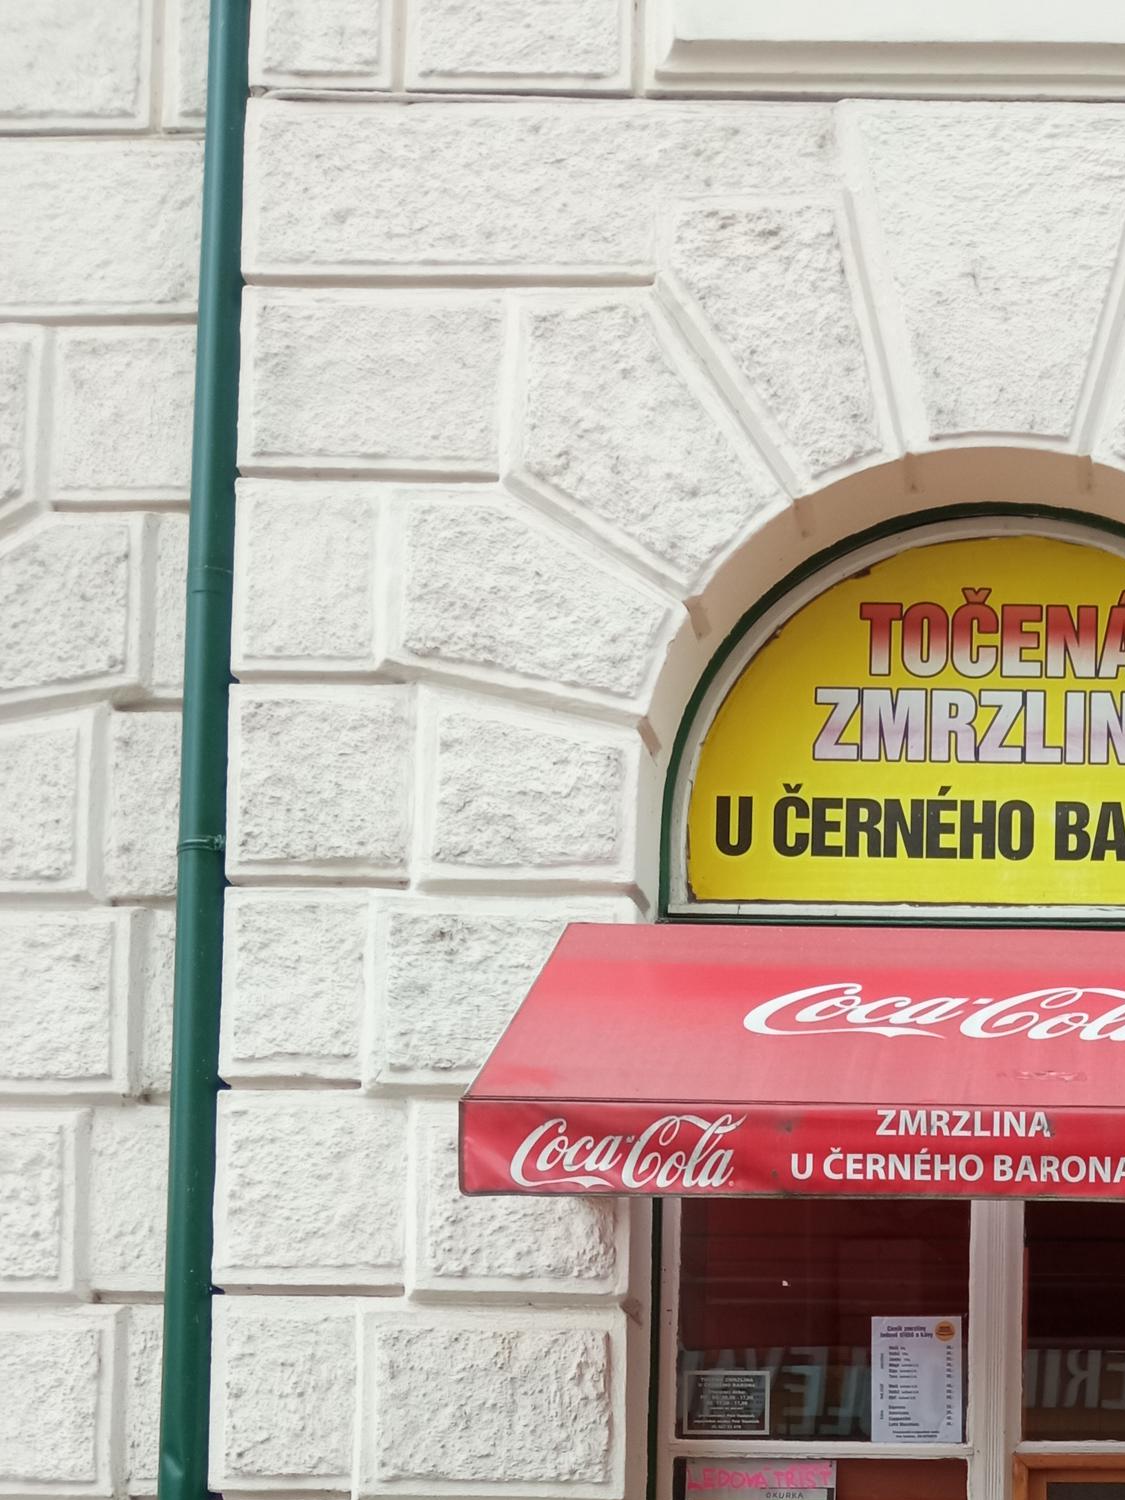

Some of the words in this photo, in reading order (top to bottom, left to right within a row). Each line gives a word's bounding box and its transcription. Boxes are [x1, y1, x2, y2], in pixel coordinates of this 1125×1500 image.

[715, 796, 752, 855] U
[774, 783, 1034, 860] ČERNÉHO
[508, 1114, 748, 1189] Coca-Cola
[876, 1109, 1050, 1140] ZMRZLINA
[791, 1154, 813, 1181] U
[822, 1146, 983, 1183] ČERNÉHO
